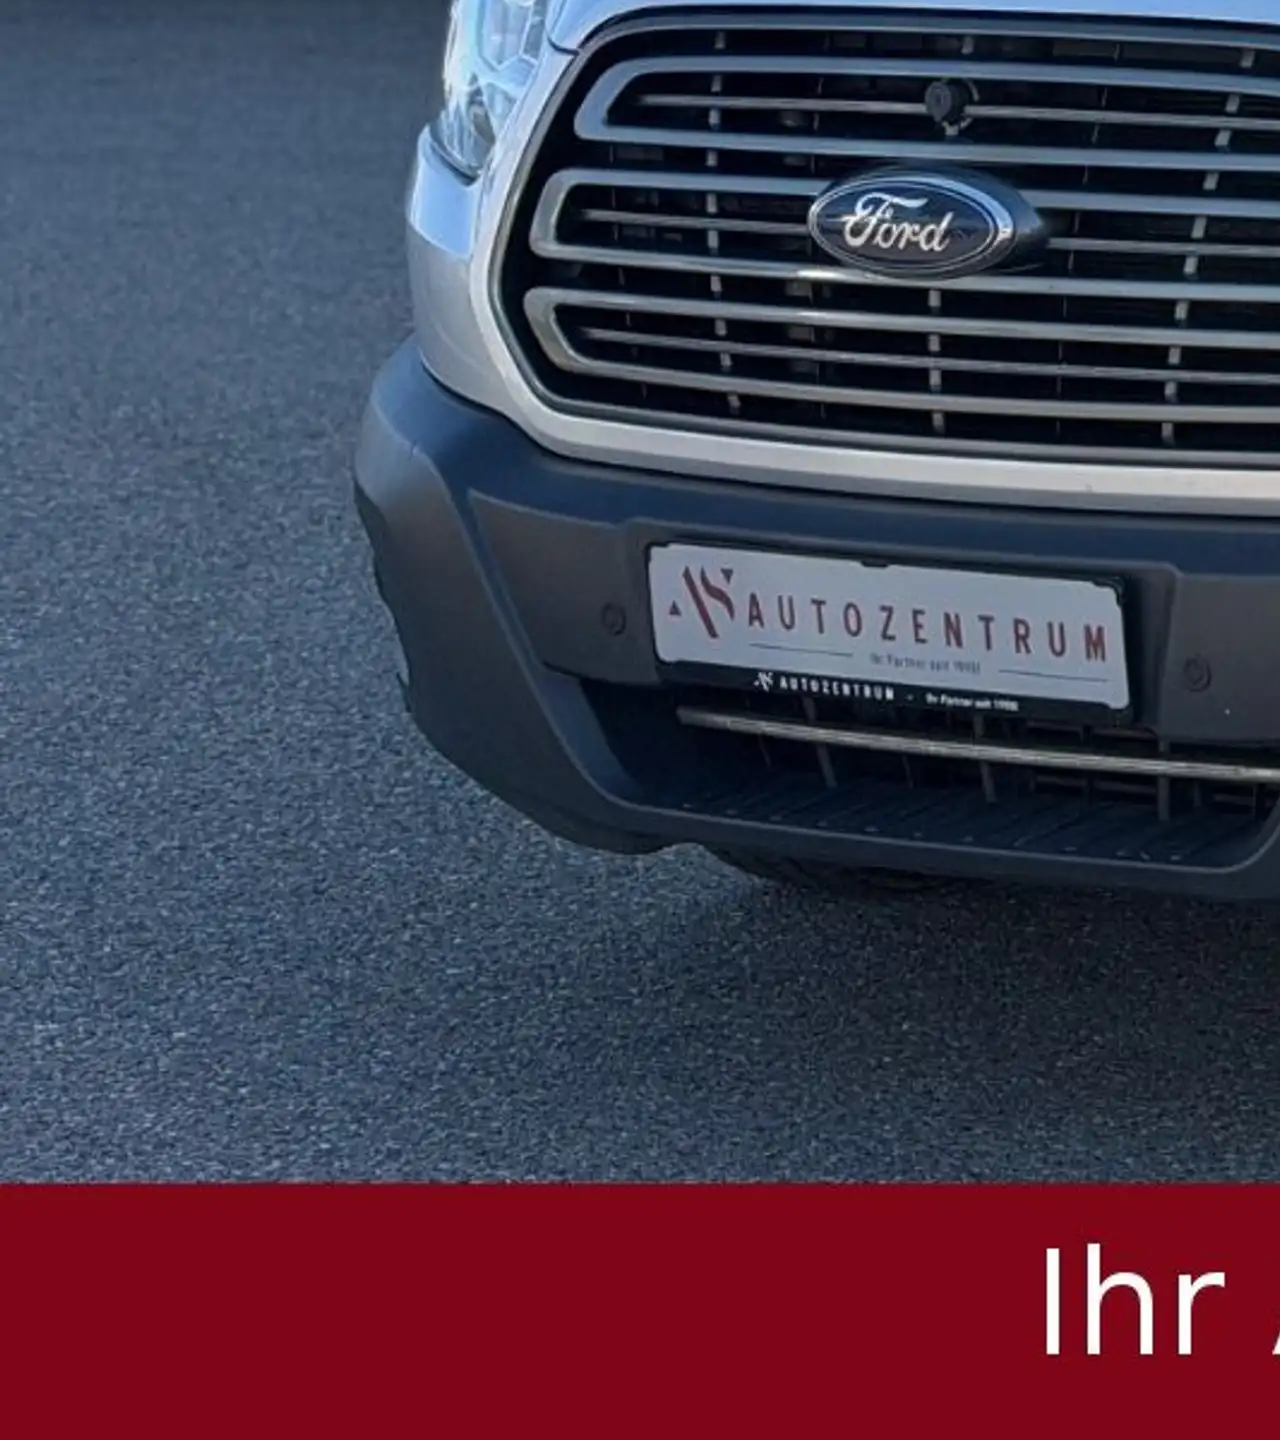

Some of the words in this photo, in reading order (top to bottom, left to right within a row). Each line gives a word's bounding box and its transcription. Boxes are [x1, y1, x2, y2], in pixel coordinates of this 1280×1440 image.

[832, 192, 954, 252] Ford
[747, 591, 1108, 662] AUTOZENTRUM
[779, 675, 895, 701] AUTOZENTRUM
